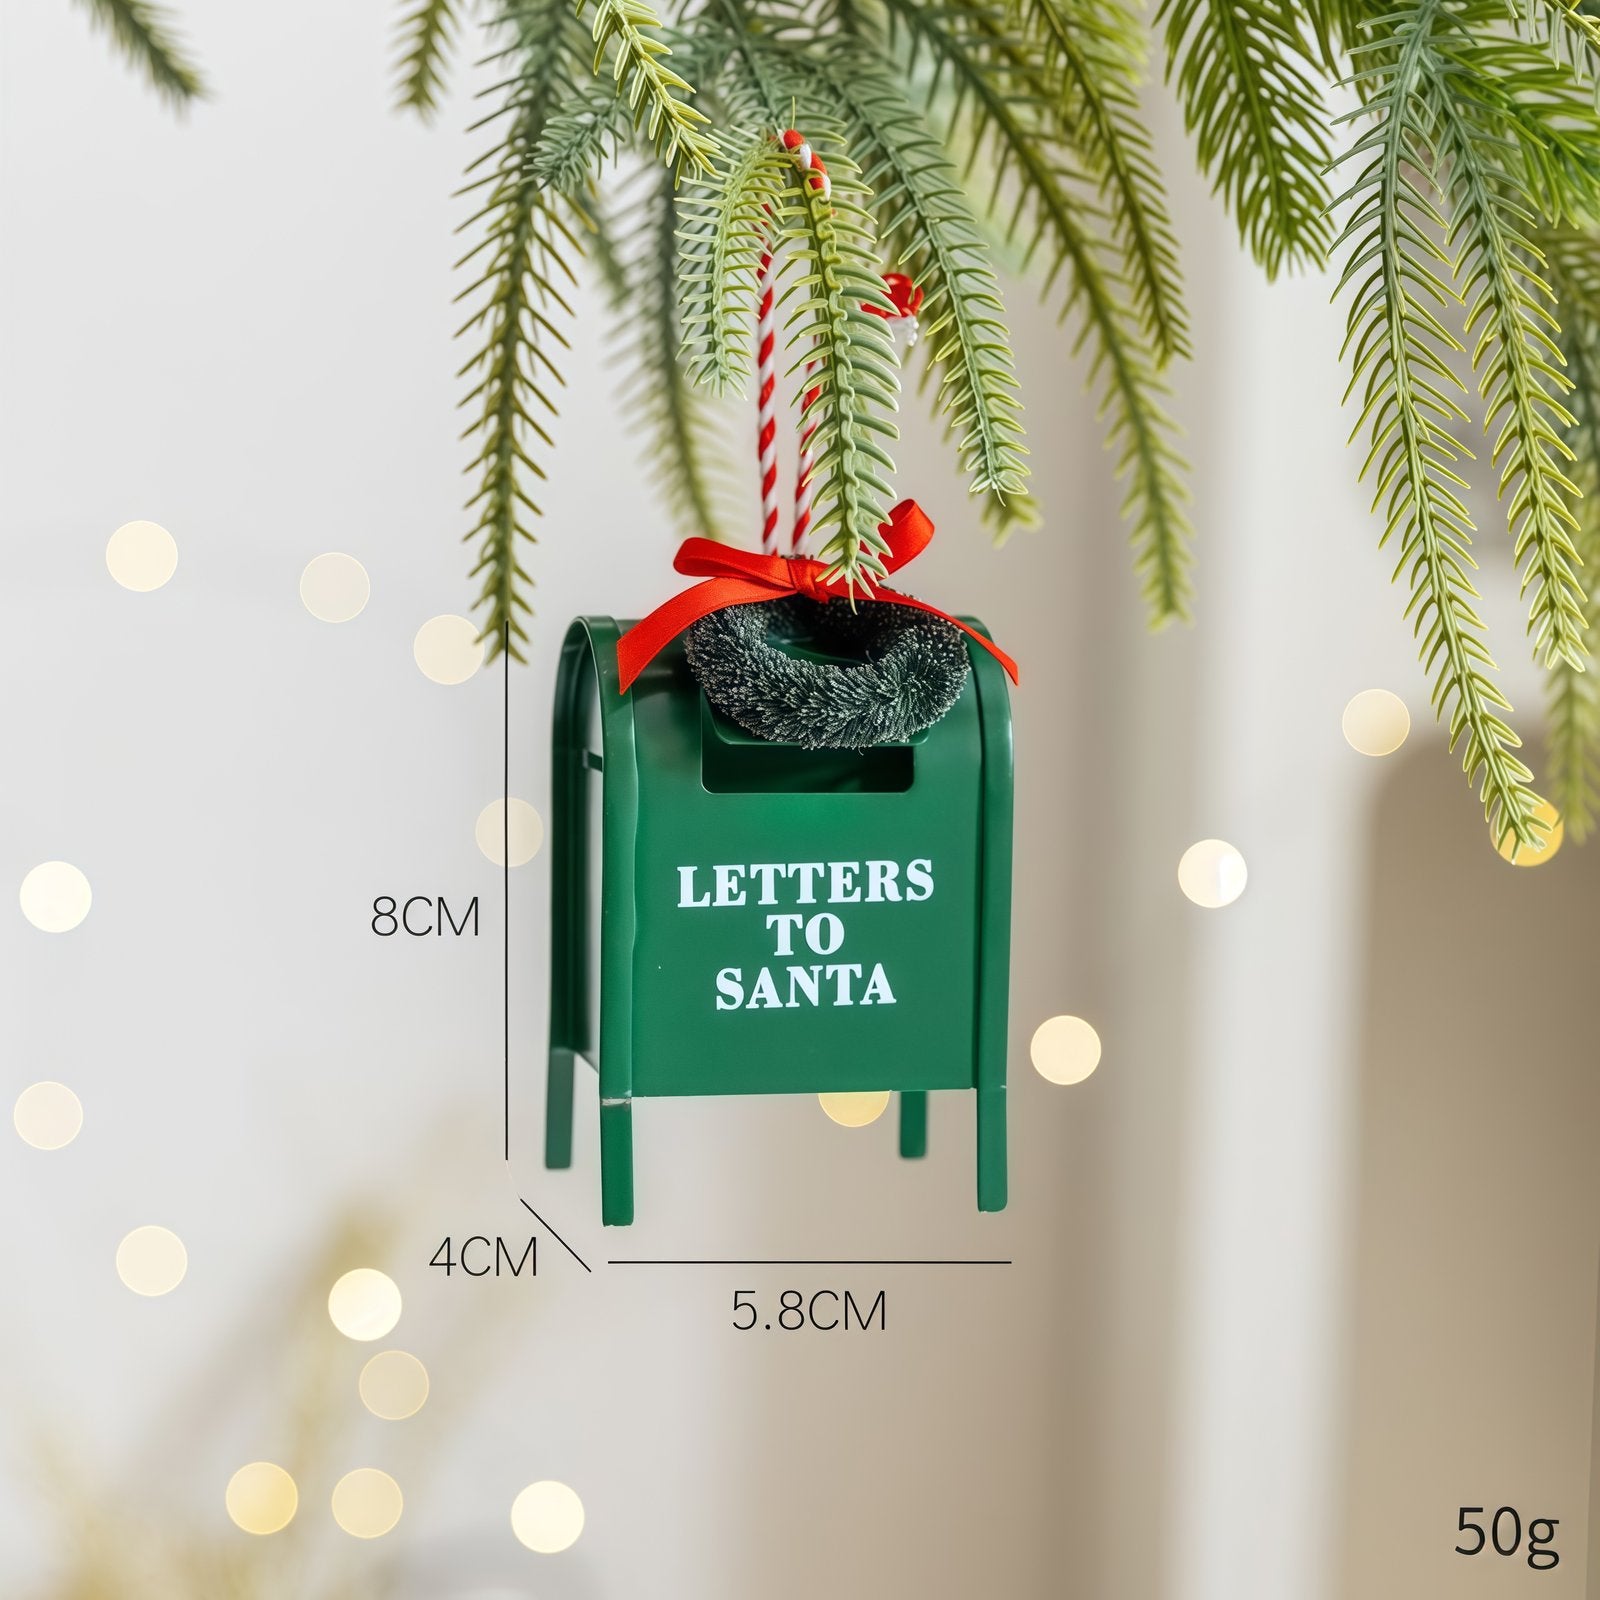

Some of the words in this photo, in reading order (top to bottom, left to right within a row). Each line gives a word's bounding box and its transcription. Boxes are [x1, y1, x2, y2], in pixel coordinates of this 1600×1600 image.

[677, 858, 935, 908] LETTERS
[766, 912, 845, 956] TO
[715, 962, 897, 1011] SANTA
